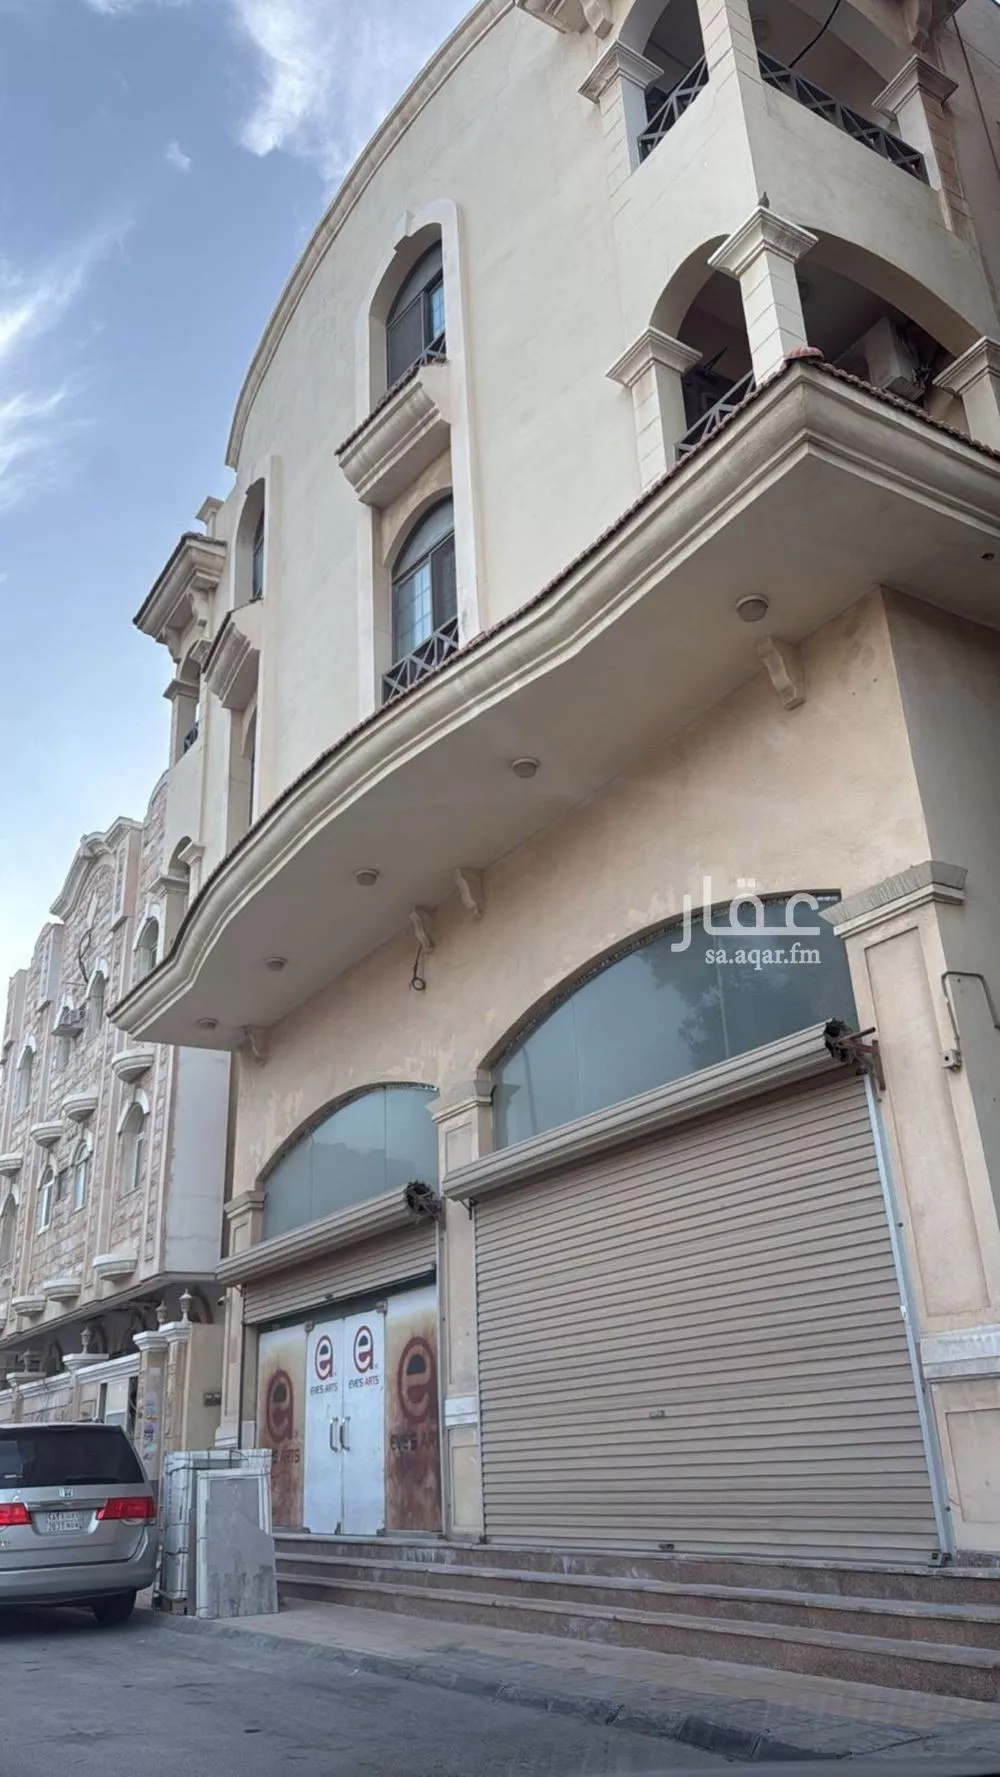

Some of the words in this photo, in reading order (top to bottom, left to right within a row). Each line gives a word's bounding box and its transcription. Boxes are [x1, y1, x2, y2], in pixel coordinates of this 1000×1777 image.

[365, 1375, 380, 1385] ARTS
[324, 1383, 338, 1393] ARTS
[280, 1448, 300, 1465] ARTS
